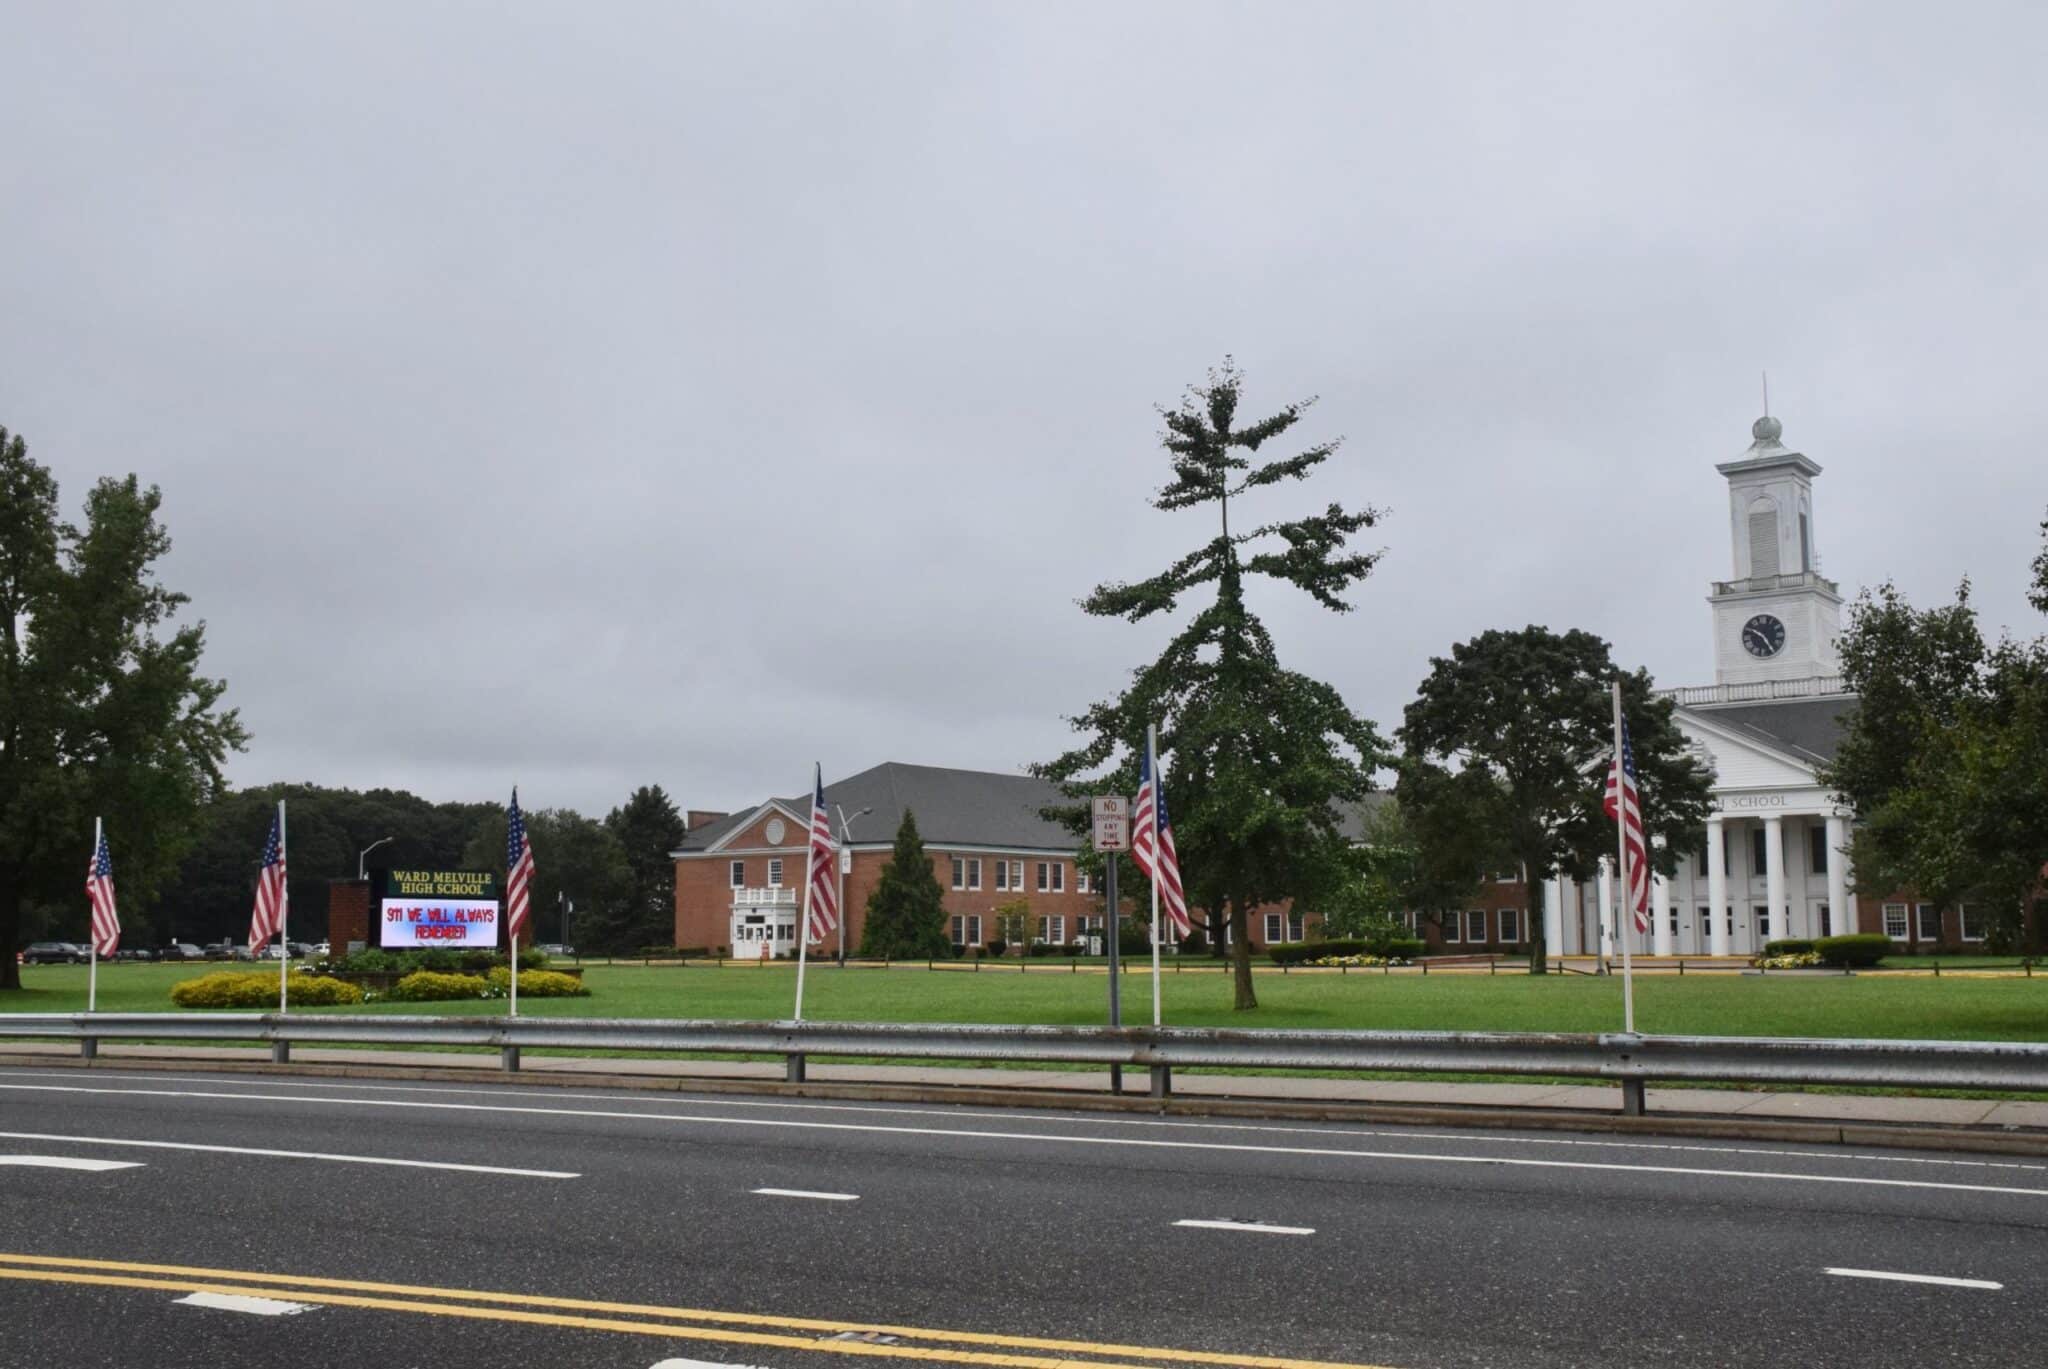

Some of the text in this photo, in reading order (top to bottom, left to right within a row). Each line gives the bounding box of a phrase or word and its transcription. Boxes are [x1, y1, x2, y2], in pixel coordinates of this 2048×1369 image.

[1103, 801, 1117, 812] NO
[1731, 795, 1788, 808] SCHOOL
[393, 870, 492, 883] WARD MELVILLE
[401, 882, 484, 895] HIGH SCHOOL
[407, 908, 422, 922] WE
[427, 908, 450, 923] WILL
[455, 908, 494, 923] ALWAYS
[415, 925, 466, 939] REMEMBER
